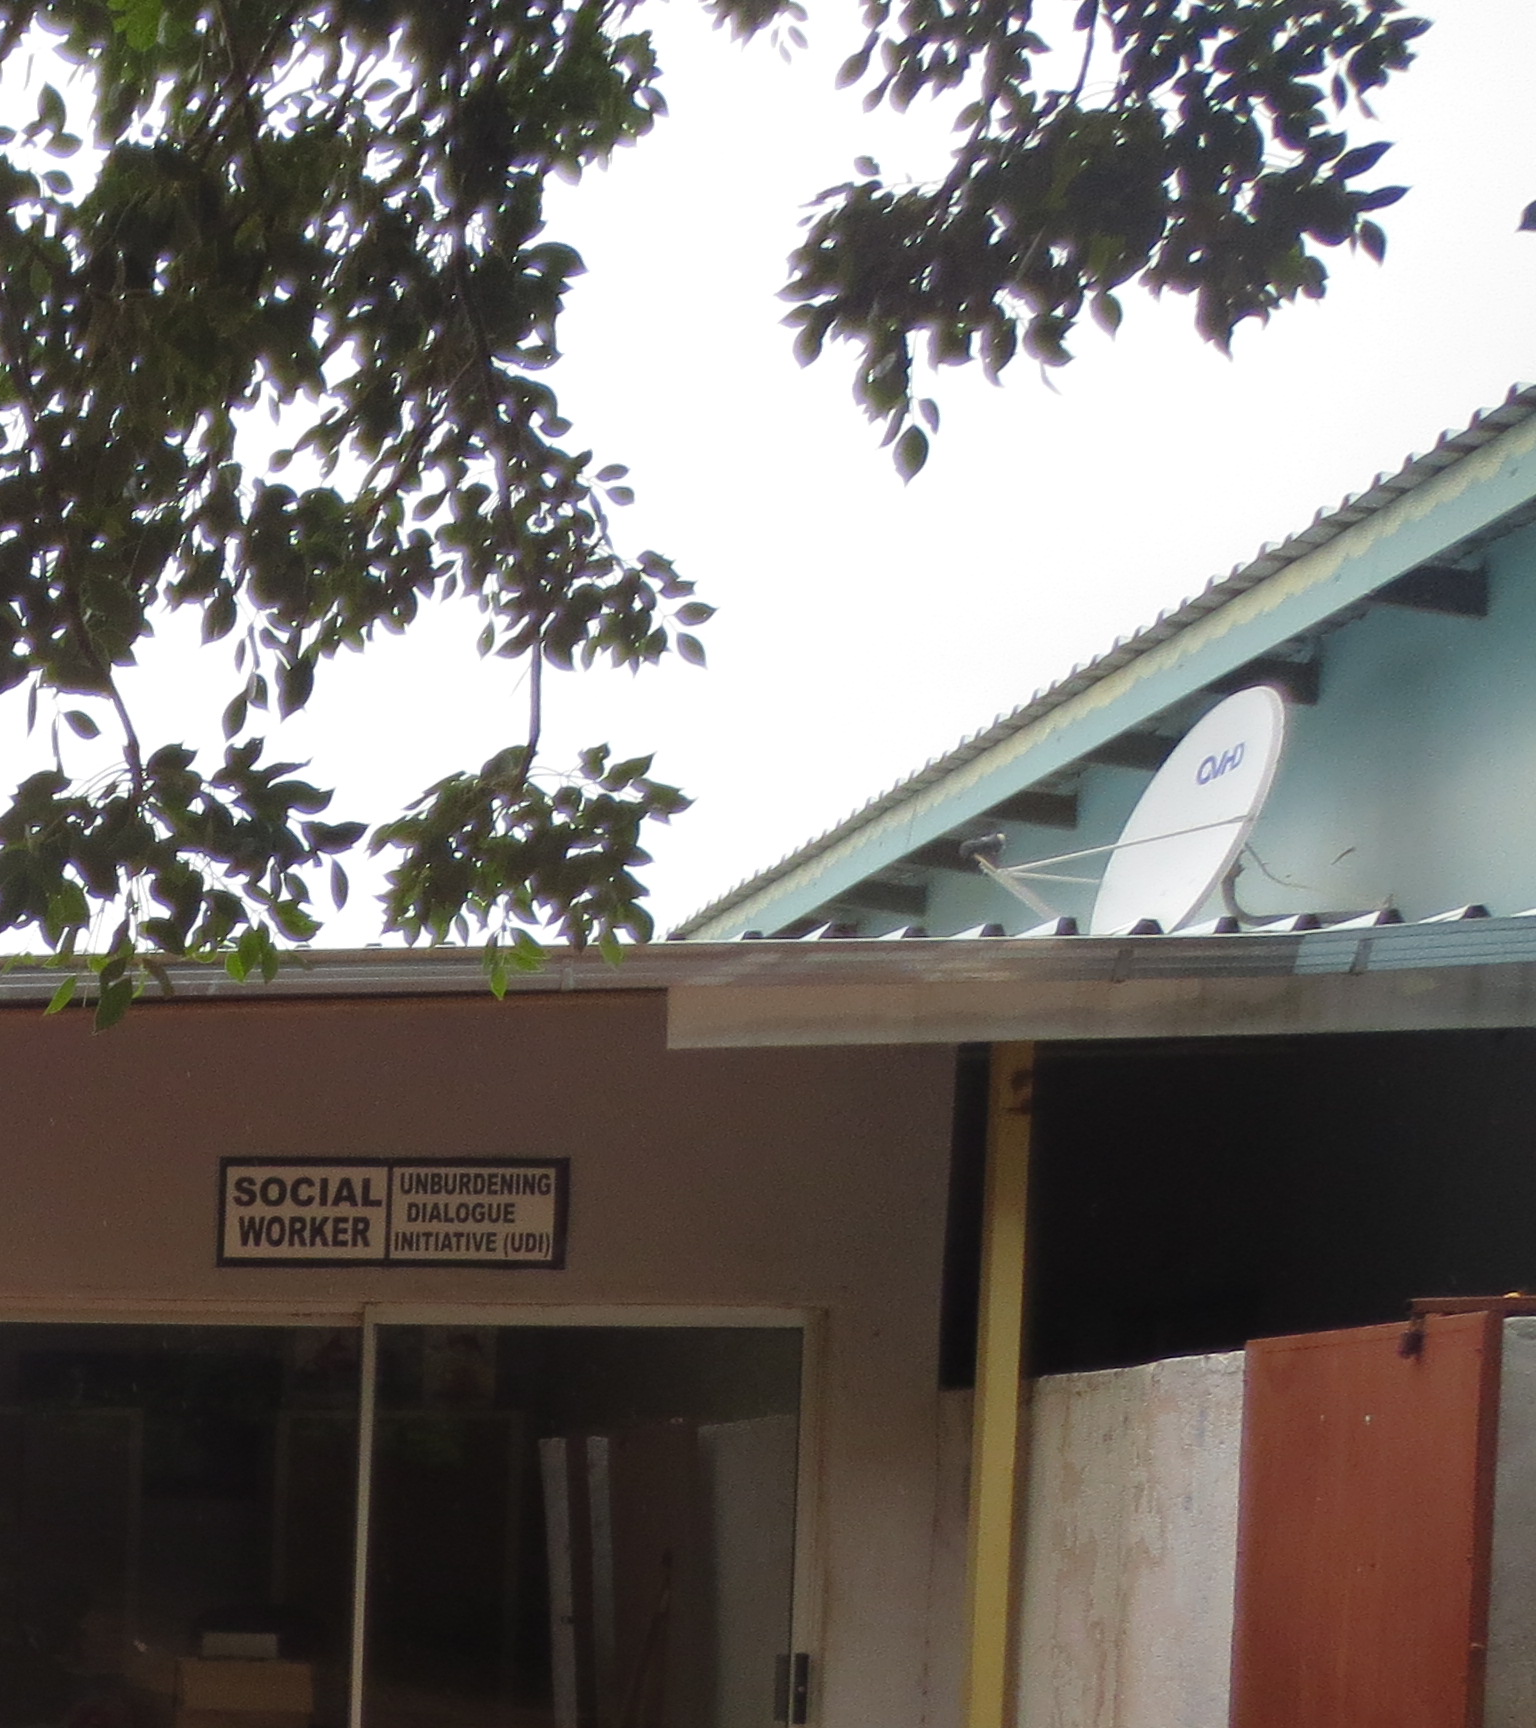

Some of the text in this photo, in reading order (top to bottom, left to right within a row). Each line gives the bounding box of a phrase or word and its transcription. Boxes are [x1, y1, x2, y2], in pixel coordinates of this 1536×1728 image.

[233, 1176, 382, 1207] SOCIAL
[400, 1173, 551, 1195] UNBURDENING
[407, 1202, 516, 1223] DIALOGUE
[238, 1215, 371, 1247] WORKER
[394, 1232, 551, 1258] INITIATIVE (UDI)
